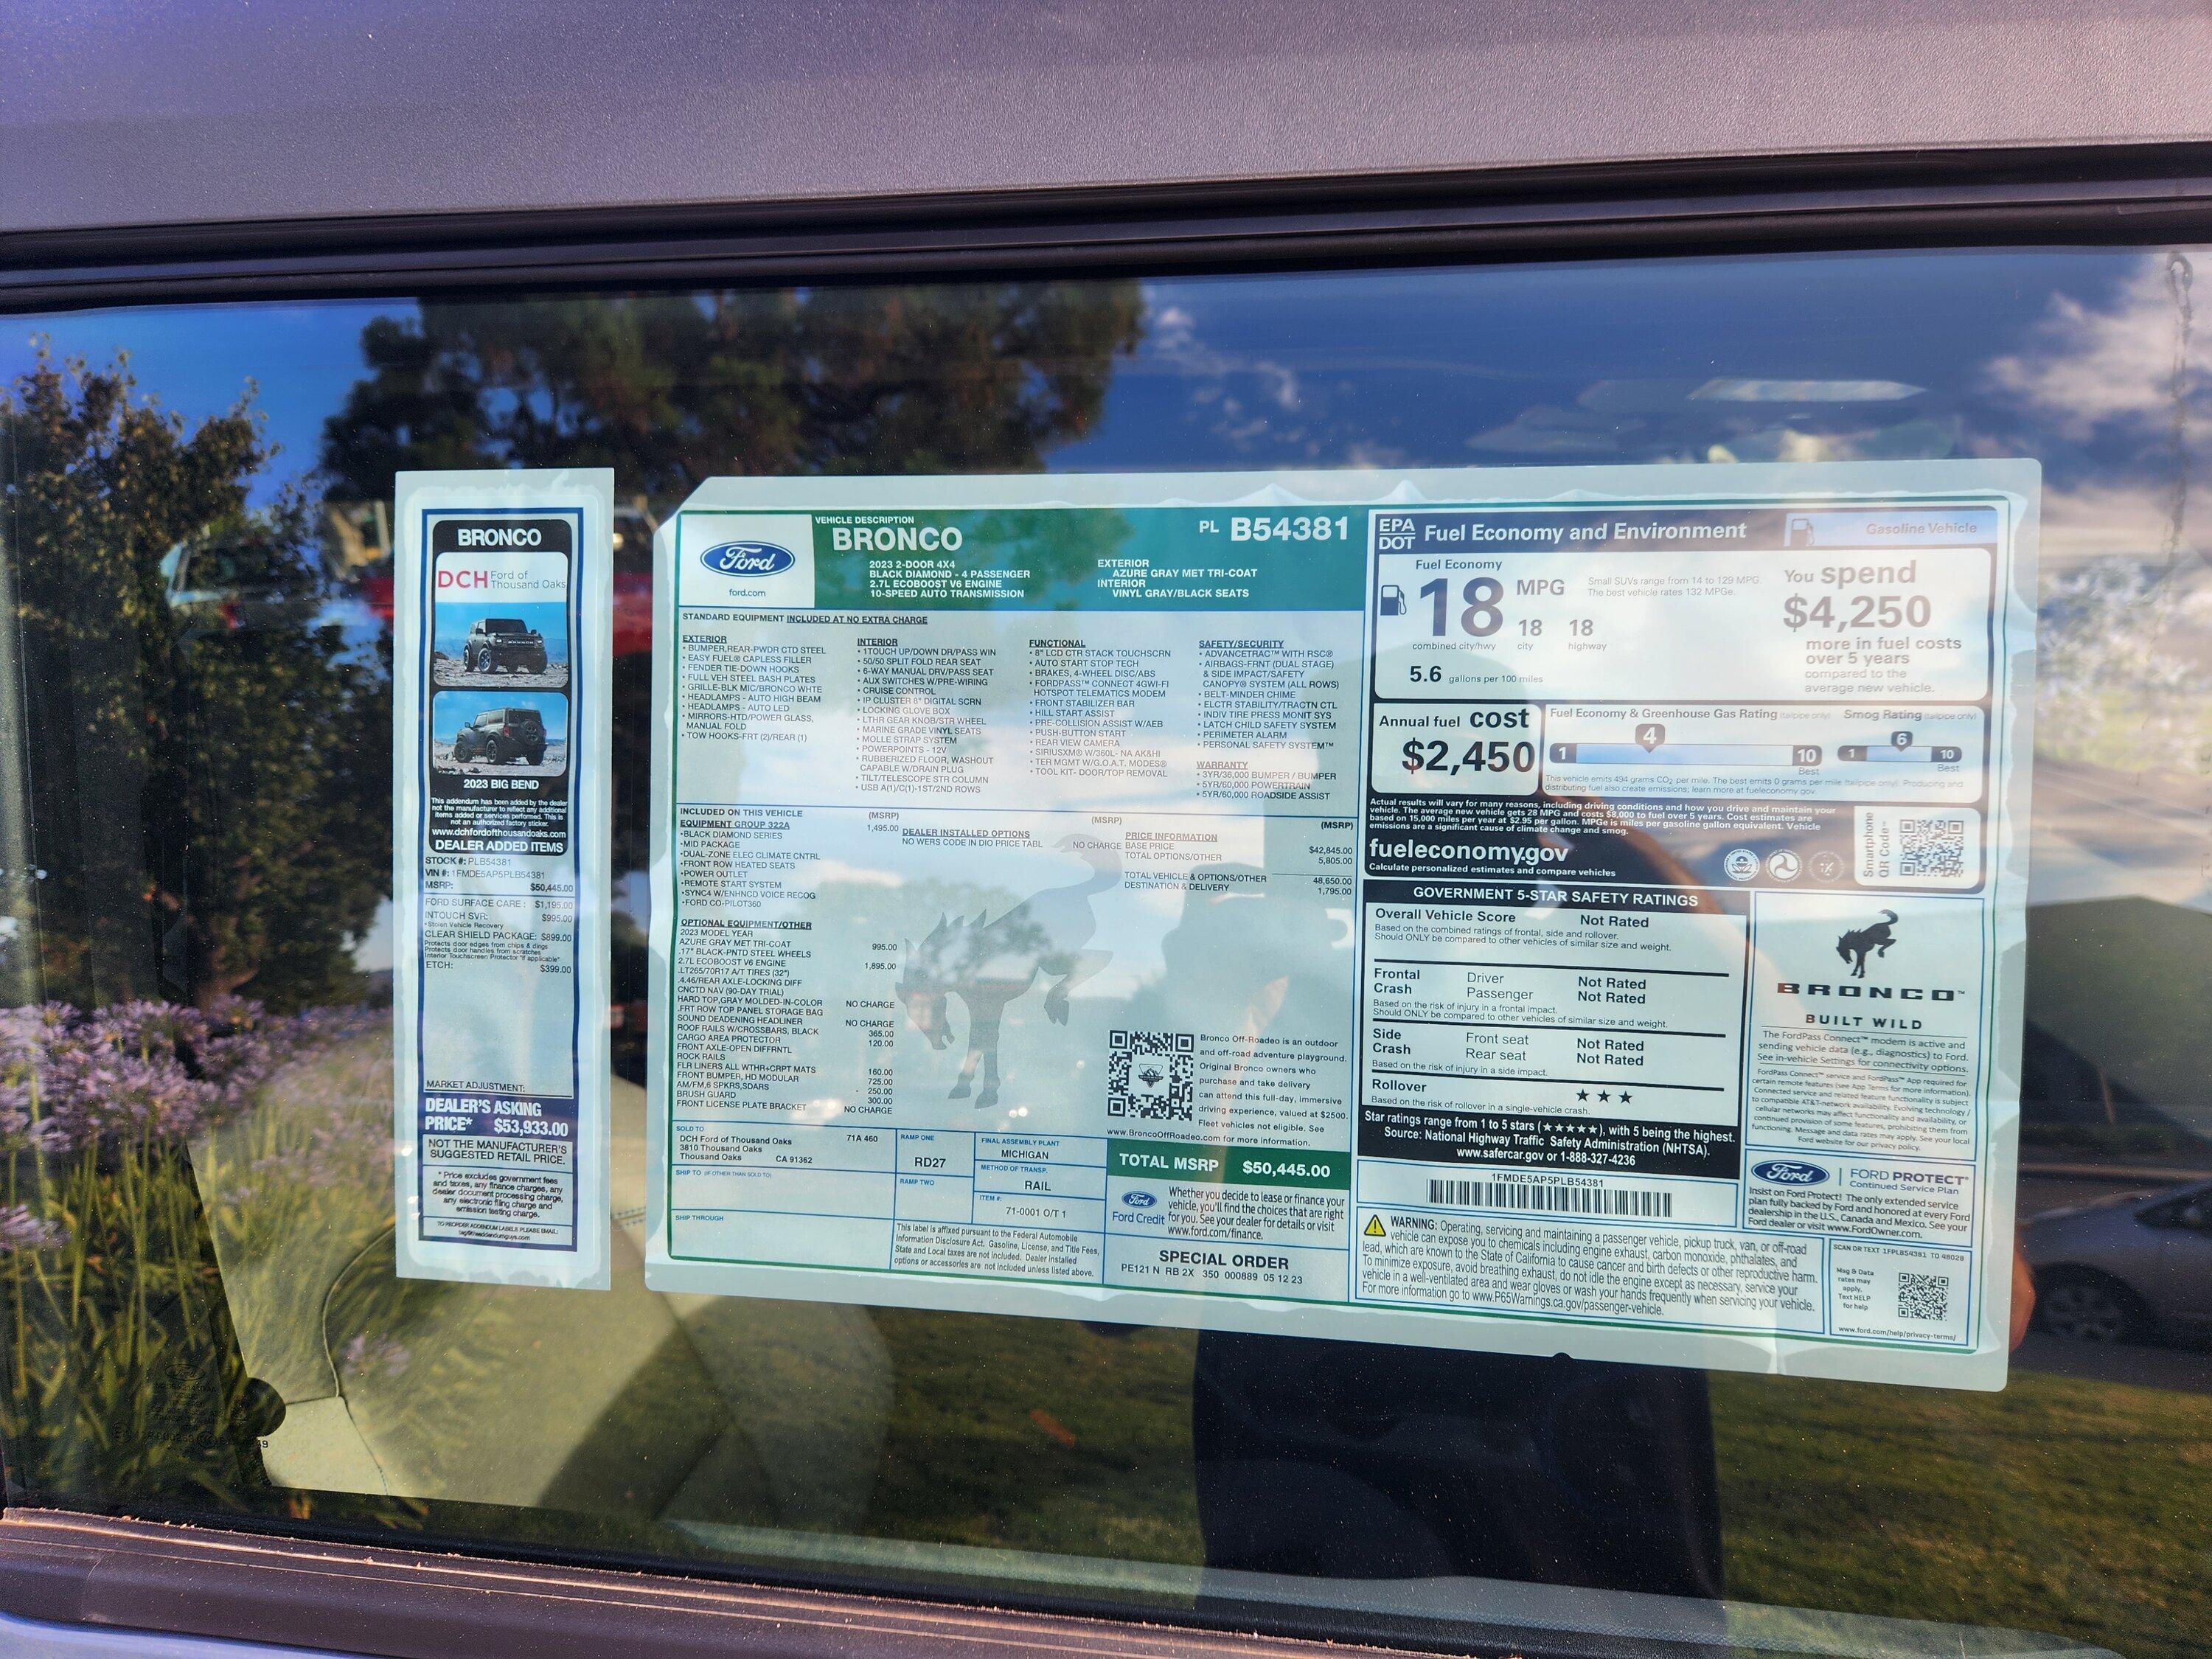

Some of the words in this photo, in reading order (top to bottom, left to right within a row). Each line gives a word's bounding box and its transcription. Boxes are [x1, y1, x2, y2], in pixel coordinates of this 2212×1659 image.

[815, 516, 853, 524] VEHICLE
[855, 516, 915, 524] DESCRIPTION
[1379, 519, 1416, 532] EPA
[1199, 520, 1220, 533] PL
[1231, 517, 1348, 541] B54381
[1425, 524, 1466, 541] Fuel
[1472, 524, 1564, 545] Economy
[1569, 523, 1607, 540] and
[1614, 522, 1747, 540] Environment
[1866, 523, 1926, 535] Gasoline
[1927, 522, 1978, 534] Vehicle
[457, 528, 542, 546] BRONCO
[832, 526, 963, 552] BRONCO
[1379, 537, 1416, 550] DOT
[720, 547, 776, 571] Ford
[869, 560, 893, 568] 2023
[895, 560, 934, 568] 2-DOOR
[936, 560, 956, 568] 4X4
[1097, 559, 1149, 567] EXTERIOR
[1416, 559, 1441, 570] Fuel
[1444, 559, 1503, 571] Economy
[491, 571, 515, 580] Ford
[518, 571, 529, 580] of
[1112, 569, 1148, 577] AZURE
[1151, 569, 1180, 577] GRAY
[1182, 569, 1205, 577] MET
[1207, 568, 1258, 577] TRI-COAT
[1784, 570, 1814, 583] You
[1820, 560, 1917, 589] spend
[437, 571, 489, 588] DCH
[491, 580, 538, 589] Thousand
[543, 580, 566, 590] Oaks
[728, 588, 766, 597] ford.com
[1516, 580, 1565, 596] MPG
[1420, 577, 1504, 638] 18
[1784, 593, 1932, 633] $4,250
[683, 613, 730, 621] STANDARD
[733, 614, 785, 622] EQUIPMENT
[786, 615, 831, 624] INCLUDED
[832, 616, 844, 624] AT
[861, 616, 890, 625] EXTRA
[892, 617, 928, 625] CHARGE
[1518, 619, 1543, 636] 18
[1568, 619, 1594, 636] 18
[682, 635, 727, 644] EXTERIOR
[857, 638, 898, 646] INTERIOR
[1029, 639, 1086, 647] FUNCTIONAL
[1198, 640, 1284, 649] SAFETY/SECURITY
[1806, 639, 1851, 650] more
[1856, 638, 1871, 650] in
[1877, 636, 1910, 650] fuel
[1916, 638, 1962, 650] costs
[1412, 641, 1456, 650] combined
[1458, 641, 1496, 652] city/hwy
[1517, 642, 1534, 652] city
[1568, 641, 1607, 652] highway
[1806, 653, 1843, 664] over
[1848, 653, 1858, 664] 5
[1865, 653, 1910, 667] years
[1409, 665, 1442, 683] 5.6
[1449, 674, 1481, 684] gallons
[1484, 676, 1498, 684] per
[1501, 675, 1517, 683] 100
[1519, 675, 1543, 683] miles
[863, 687, 894, 695] CRUISE
[895, 687, 936, 695] CONTROL
[1379, 716, 1430, 728] Annual
[1433, 715, 1461, 728] fuel
[1470, 708, 1530, 728] cost
[1203, 731, 1253, 739] PERIMETER
[1256, 731, 1287, 740] ALARM
[1643, 727, 1657, 745] 4
[1896, 734, 1907, 745] 6
[1401, 737, 1535, 776] $2,450
[1558, 747, 1567, 759] 1
[1797, 749, 1817, 762] 10
[1848, 749, 1855, 759] 1
[1939, 749, 1955, 759] 10
[1197, 761, 1248, 770] WARRANTY
[463, 779, 488, 789] 2023
[491, 780, 509, 789] BIG
[511, 780, 540, 790] BEND
[680, 819, 732, 829] EQUIPMENT
[734, 821, 765, 829] GROUP
[768, 821, 790, 830] 322A
[431, 828, 566, 838] www.dchfordofthousandoaks.com
[435, 839, 484, 851] DEALER
[485, 841, 529, 852] ADDED
[531, 842, 564, 852] ITEMS
[1309, 846, 1353, 855] $42,845.00
[1863, 812, 1874, 877] Smartphone
[1368, 838, 1568, 865] fueleconomy.gov
[425, 856, 457, 865] STOCK
[467, 858, 512, 866] PLB54381
[425, 869, 440, 877] VIN
[451, 870, 546, 879] 1FMDE5AP5PLB54381
[425, 881, 453, 889] MSRP:
[530, 883, 574, 893] $50,445.00
[1413, 886, 1514, 900] GOVERNMENT
[1517, 889, 1568, 902] 5-STAR
[1571, 891, 1629, 905] SAFETY
[1632, 893, 1699, 907] RATINGS
[1375, 908, 1422, 920] Overall
[1425, 909, 1473, 922] Vehicle
[1476, 911, 1517, 923] Score
[1580, 914, 1604, 927] Not
[1608, 915, 1649, 928] Rated
[425, 930, 456, 938] CLEAR
[457, 931, 490, 939] SHIELD
[493, 932, 537, 940] PACKAGE:
[540, 933, 572, 942] $899.00
[872, 943, 897, 951] 995.00
[425, 961, 453, 969] ETCH:
[540, 964, 571, 973] $399.00
[1467, 972, 1504, 984] Driver
[1806, 1014, 1863, 1026] BUILT
[1872, 1018, 1922, 1030] WILD
[1200, 1034, 1230, 1042] Bronco
[1231, 1035, 1280, 1045] Off-Roadeo
[1282, 1037, 1290, 1046] is
[1304, 1038, 1338, 1048] outdoor
[426, 1080, 464, 1089] MARKET
[465, 1082, 526, 1093] ADJUSTMENT:
[1372, 1079, 1427, 1093] Rollover
[493, 1101, 542, 1117] ASKING
[494, 1118, 568, 1137] $53,933.00
[846, 1134, 862, 1142] 71A
[864, 1135, 878, 1143] 460
[430, 1150, 494, 1160] SUGGESTED
[497, 1152, 531, 1162] RETAIL
[534, 1154, 566, 1164] PRICE.
[1001, 1150, 1049, 1160] MICHIGAN
[1456, 1148, 1544, 1163] www.safercar.gov
[1547, 1153, 1558, 1162] or
[1560, 1151, 1636, 1166] 1-888-327-4236
[914, 1157, 947, 1169] RD27
[1119, 1153, 1169, 1169] TOTAL
[1174, 1156, 1219, 1172] MSRP
[1242, 1160, 1331, 1178] $50,445.00
[1491, 1172, 1604, 1187] 1FMDE5AP5PLB54381
[1767, 1164, 1812, 1183] Ford
[1850, 1168, 1889, 1180] FORD
[1024, 1180, 1051, 1192] RAIL
[1391, 1216, 1438, 1230] WARNING:
[1159, 1250, 1227, 1267] SPECIAL
[1231, 1254, 1290, 1270] ORDER
